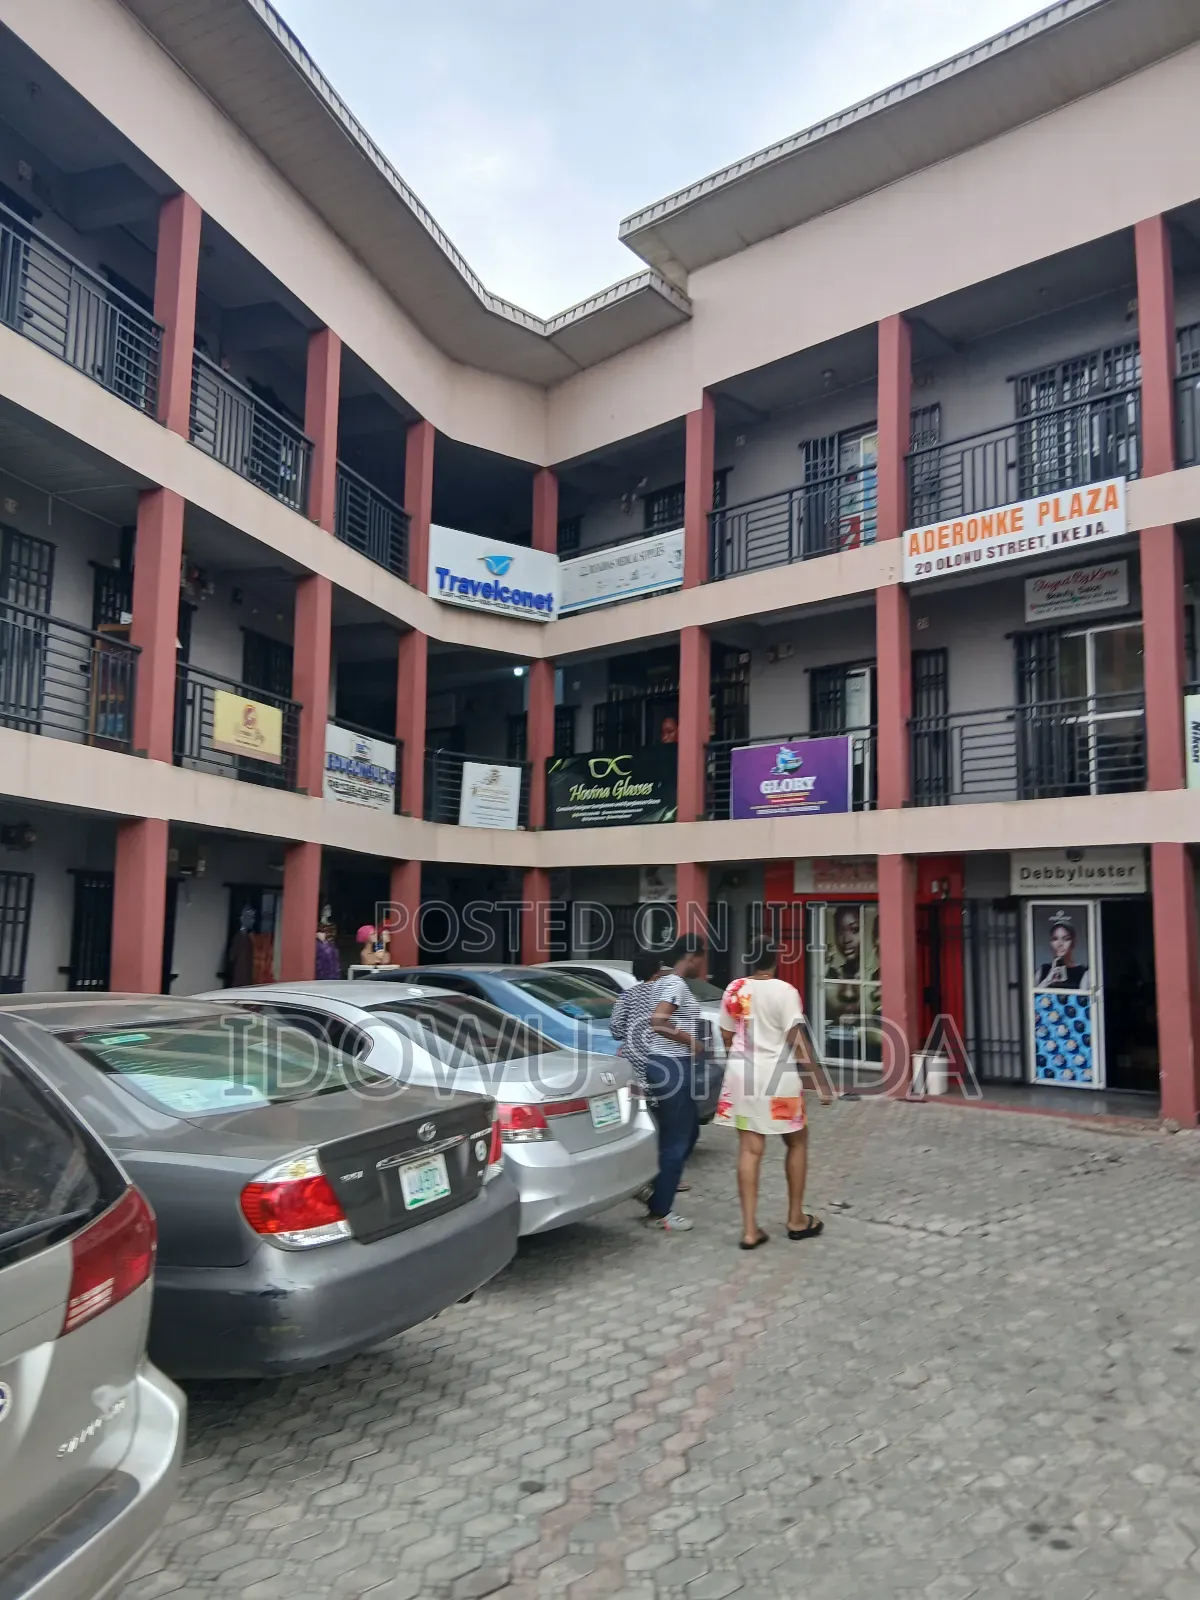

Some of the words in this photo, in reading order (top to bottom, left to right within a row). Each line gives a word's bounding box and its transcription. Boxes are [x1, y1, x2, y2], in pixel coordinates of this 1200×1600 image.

[909, 506, 1025, 557] ADERONKE
[1037, 484, 1120, 527] PLAZA
[914, 561, 933, 576] 20
[434, 566, 554, 613] Travelconet
[611, 775, 655, 800] Glasses
[759, 776, 817, 794] GLORY
[1019, 864, 1136, 882] Debbyluster
